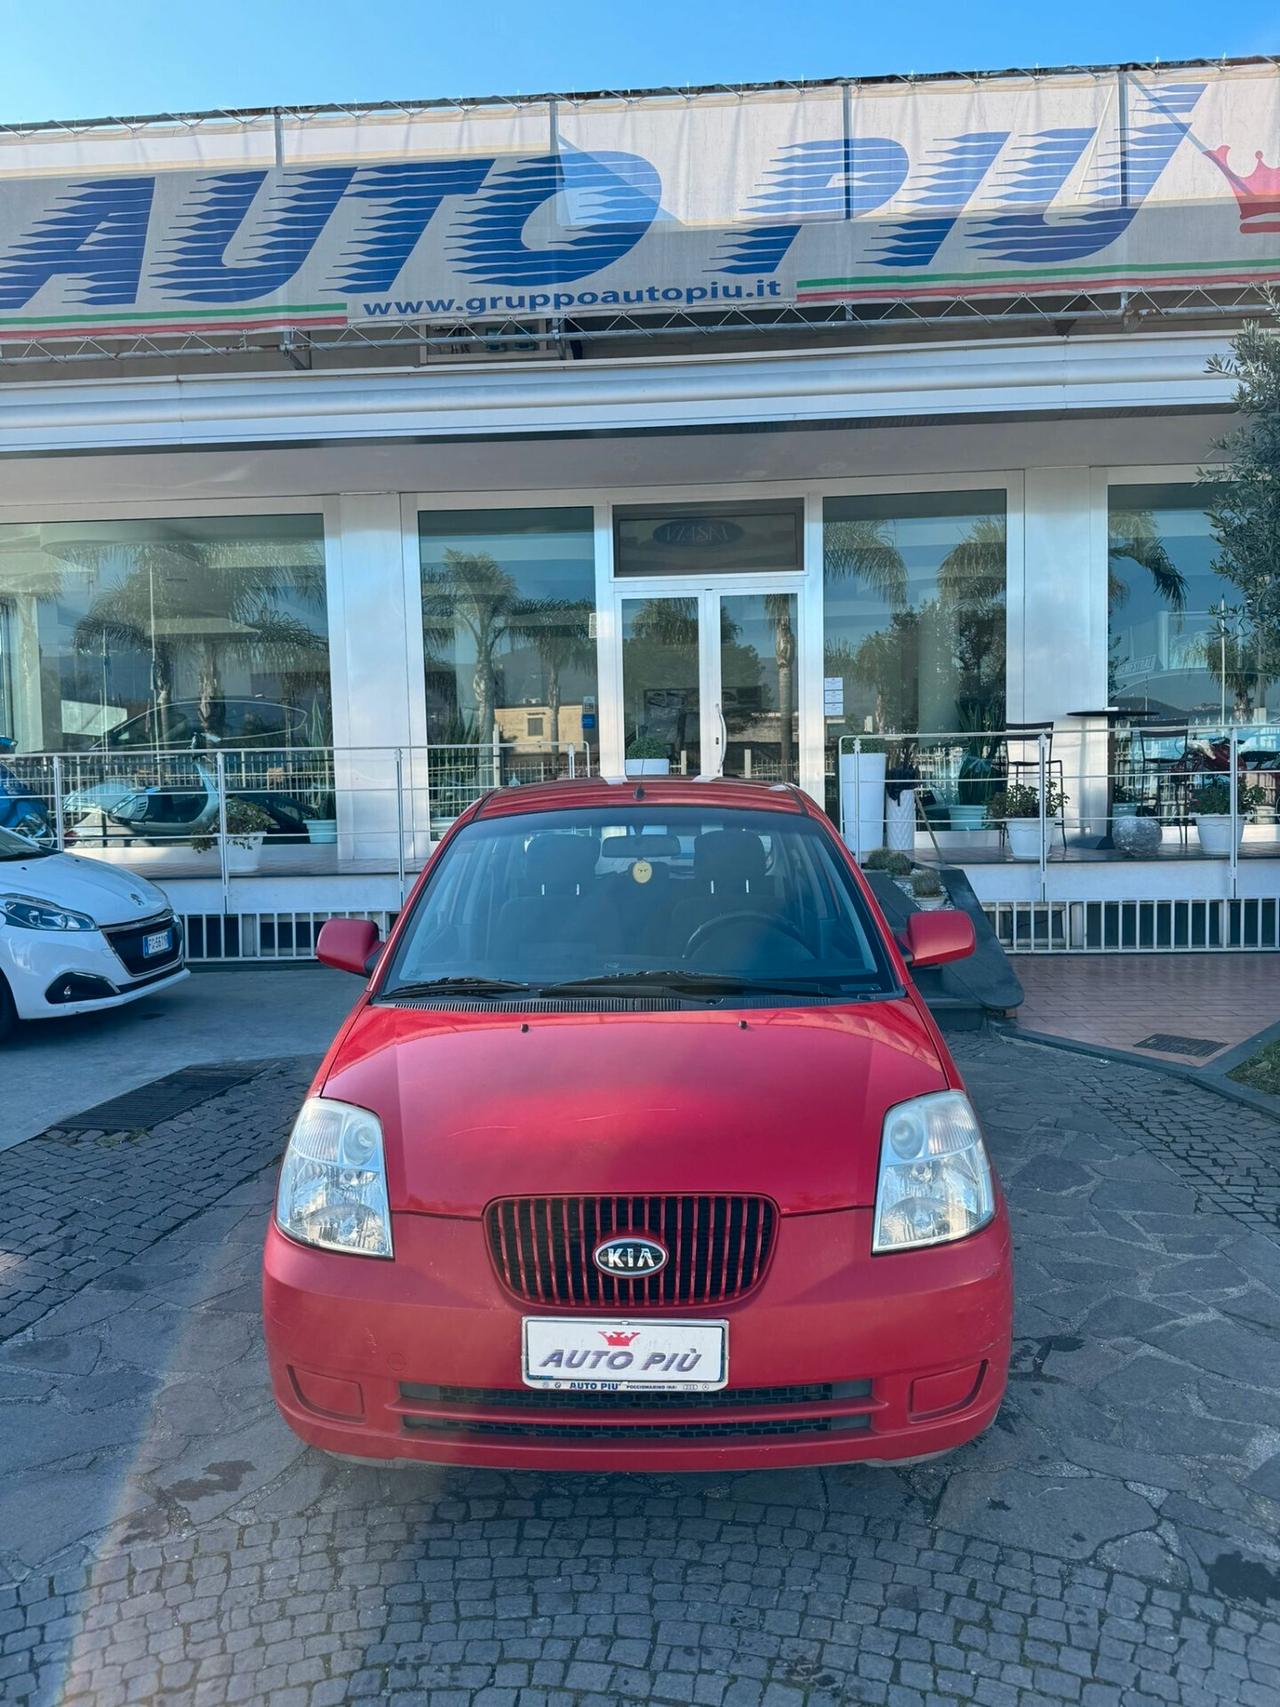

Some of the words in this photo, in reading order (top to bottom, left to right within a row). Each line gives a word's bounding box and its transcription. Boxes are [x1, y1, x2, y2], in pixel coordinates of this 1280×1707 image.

[0, 151, 661, 309] AUTO
[363, 279, 781, 316] www.gruppoautopiu.it
[607, 1248, 655, 1268] KIA
[539, 1349, 635, 1370] AUTO
[640, 1347, 702, 1373] PIÙ
[569, 1382, 597, 1390] AUTO
